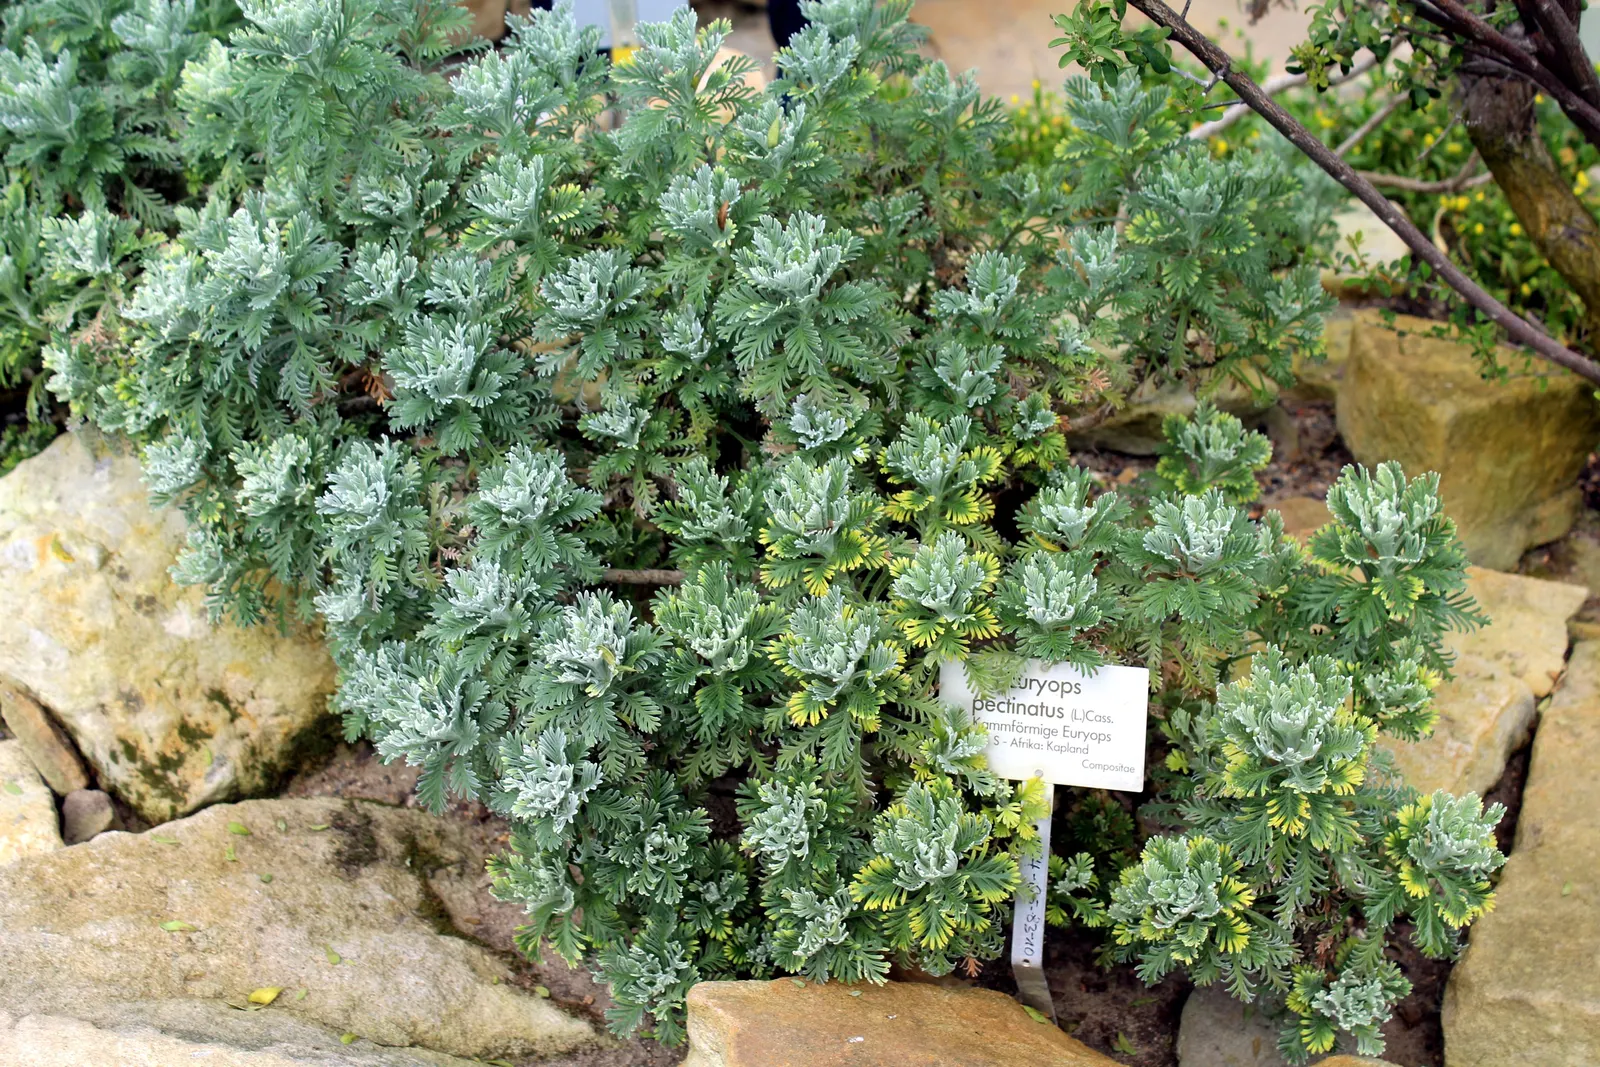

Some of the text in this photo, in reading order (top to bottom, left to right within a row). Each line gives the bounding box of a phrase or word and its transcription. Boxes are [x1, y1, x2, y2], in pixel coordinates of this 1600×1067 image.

[972, 697, 1064, 719] pectinatus
[1063, 725, 1112, 744] Euryops
[1010, 737, 1043, 751] Afrika:
[1046, 741, 1089, 755] Kapland
[1082, 759, 1135, 774] Compositae
